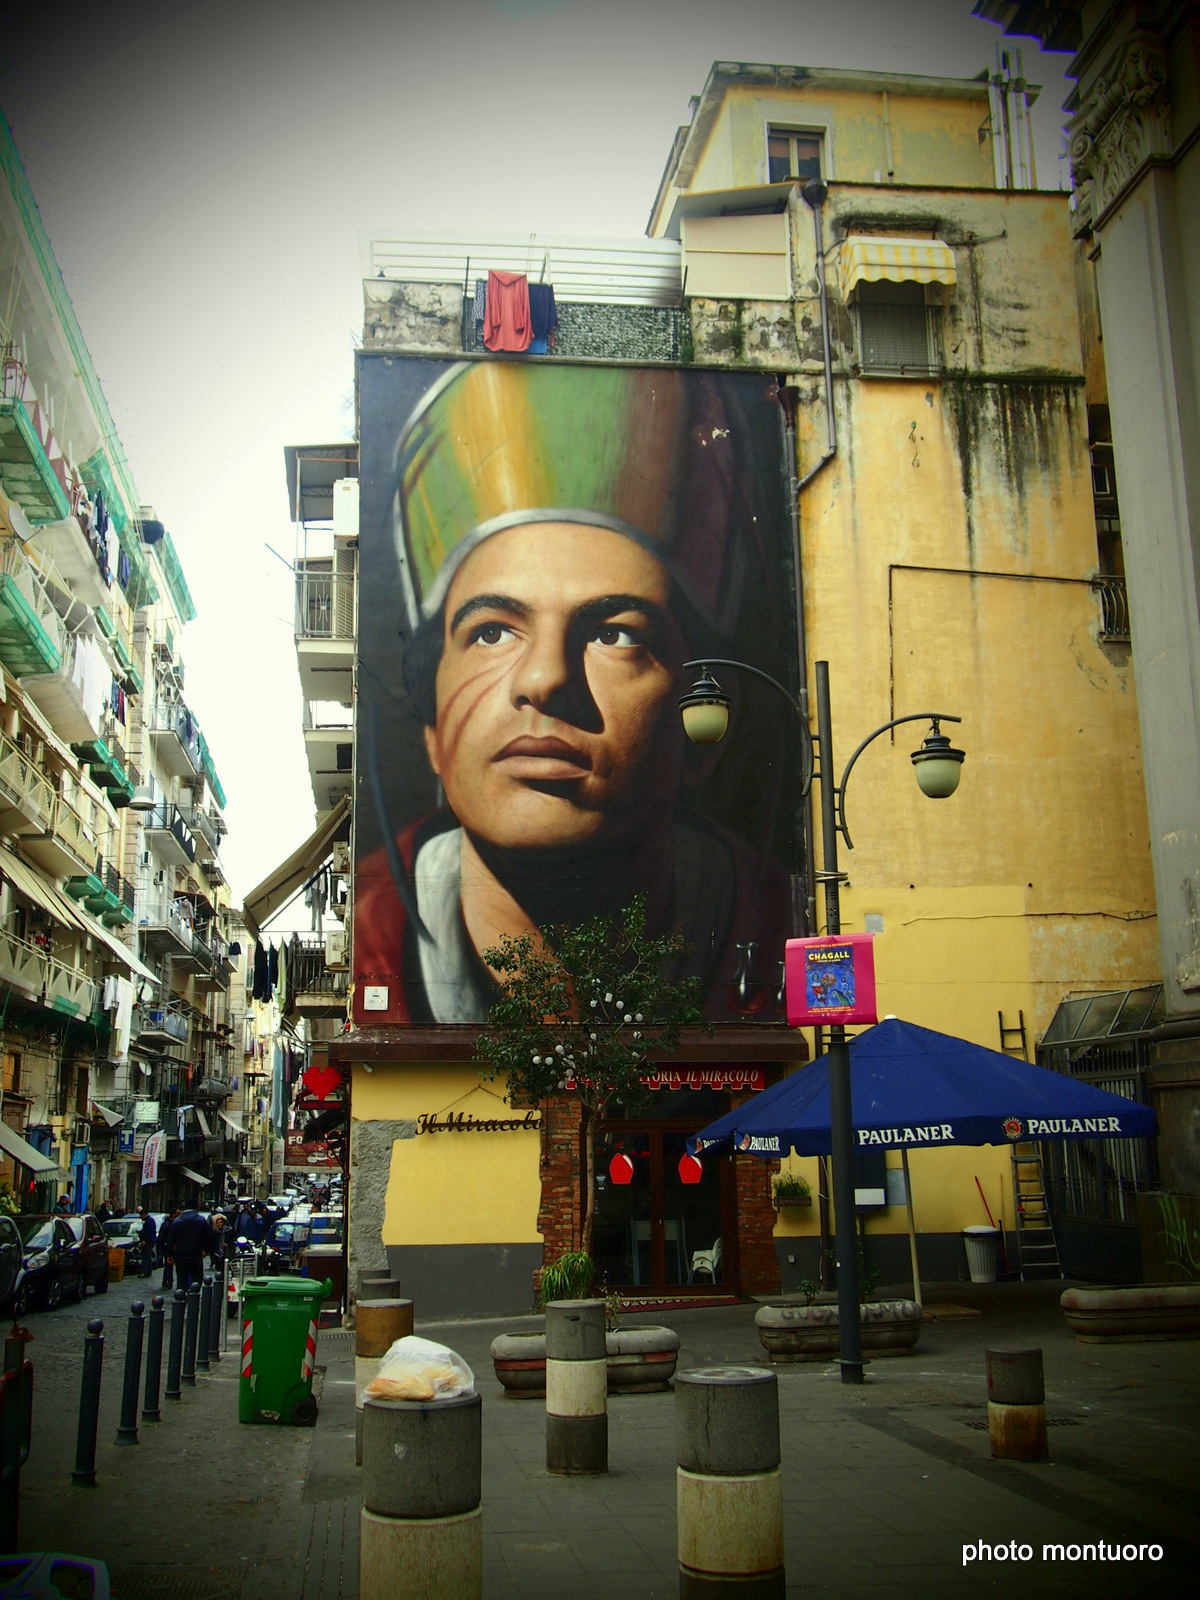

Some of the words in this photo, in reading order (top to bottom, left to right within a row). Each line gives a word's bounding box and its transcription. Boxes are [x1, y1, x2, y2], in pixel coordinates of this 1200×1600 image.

[808, 951, 850, 960] CHAGALL
[686, 1070, 697, 1082] IL
[699, 1069, 759, 1082] MIRACOLO
[438, 1111, 544, 1132] Miracolo
[1027, 1116, 1122, 1134] PAULANER
[857, 1124, 955, 1145] PAULANER
[749, 1136, 780, 1151] PAULANER
